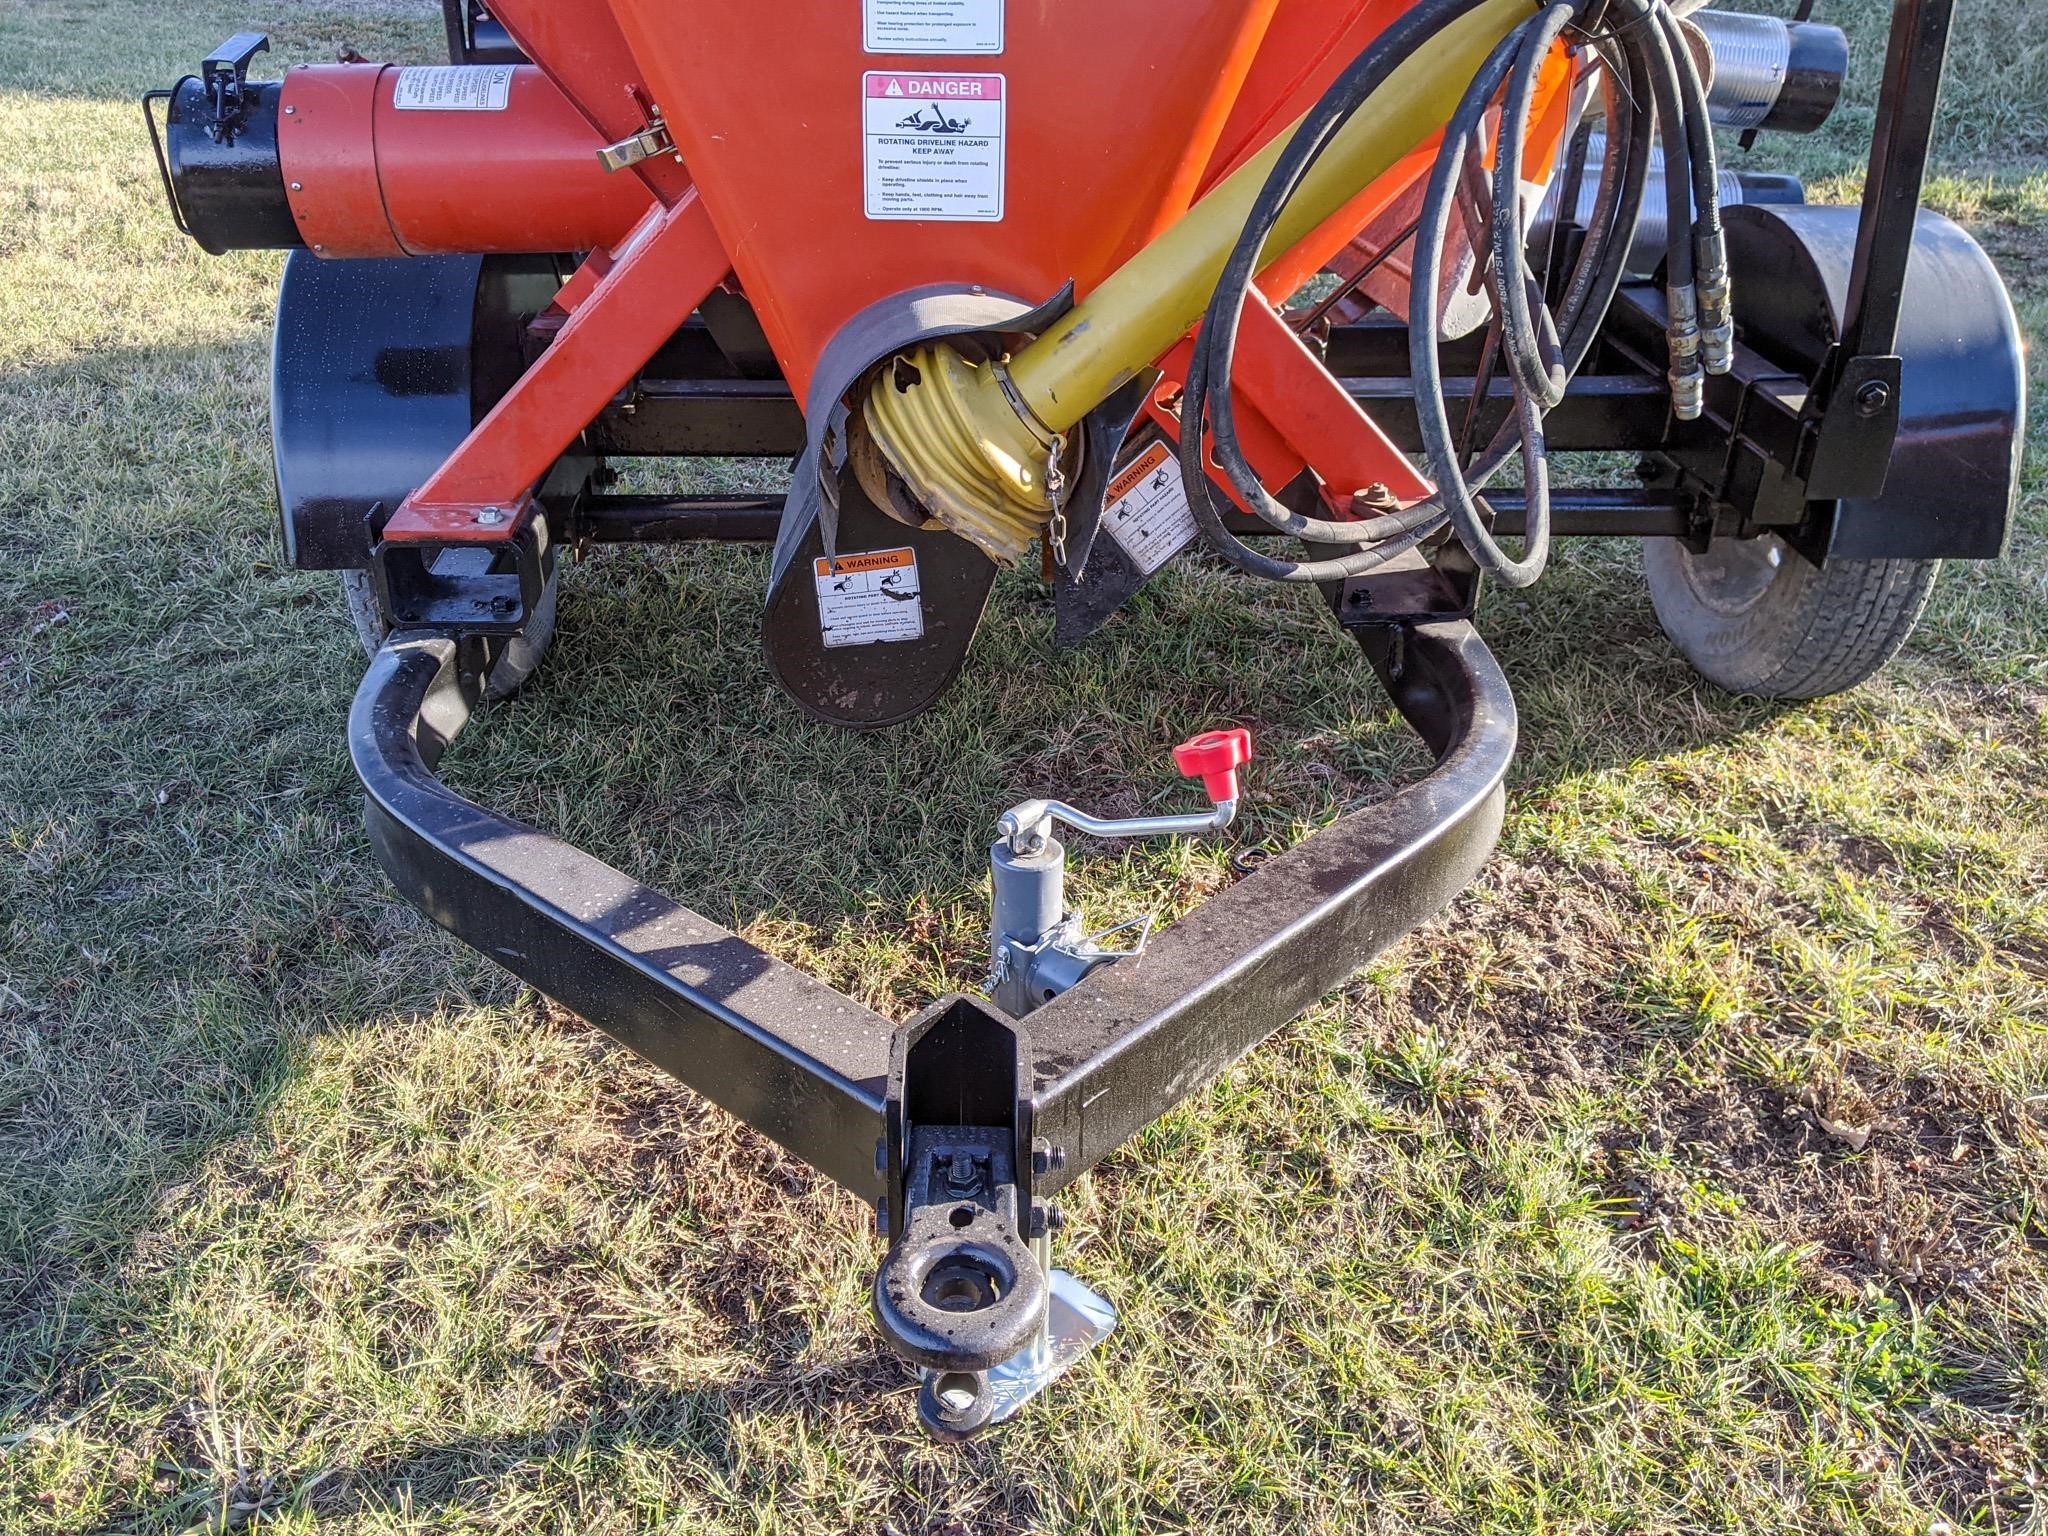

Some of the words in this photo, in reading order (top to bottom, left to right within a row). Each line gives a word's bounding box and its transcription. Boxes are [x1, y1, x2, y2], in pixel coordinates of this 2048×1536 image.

[908, 80, 982, 96] DANGER
[1495, 256, 1504, 275] PSI
[1113, 456, 1156, 493] WARNING
[847, 556, 899, 568] WARNING
